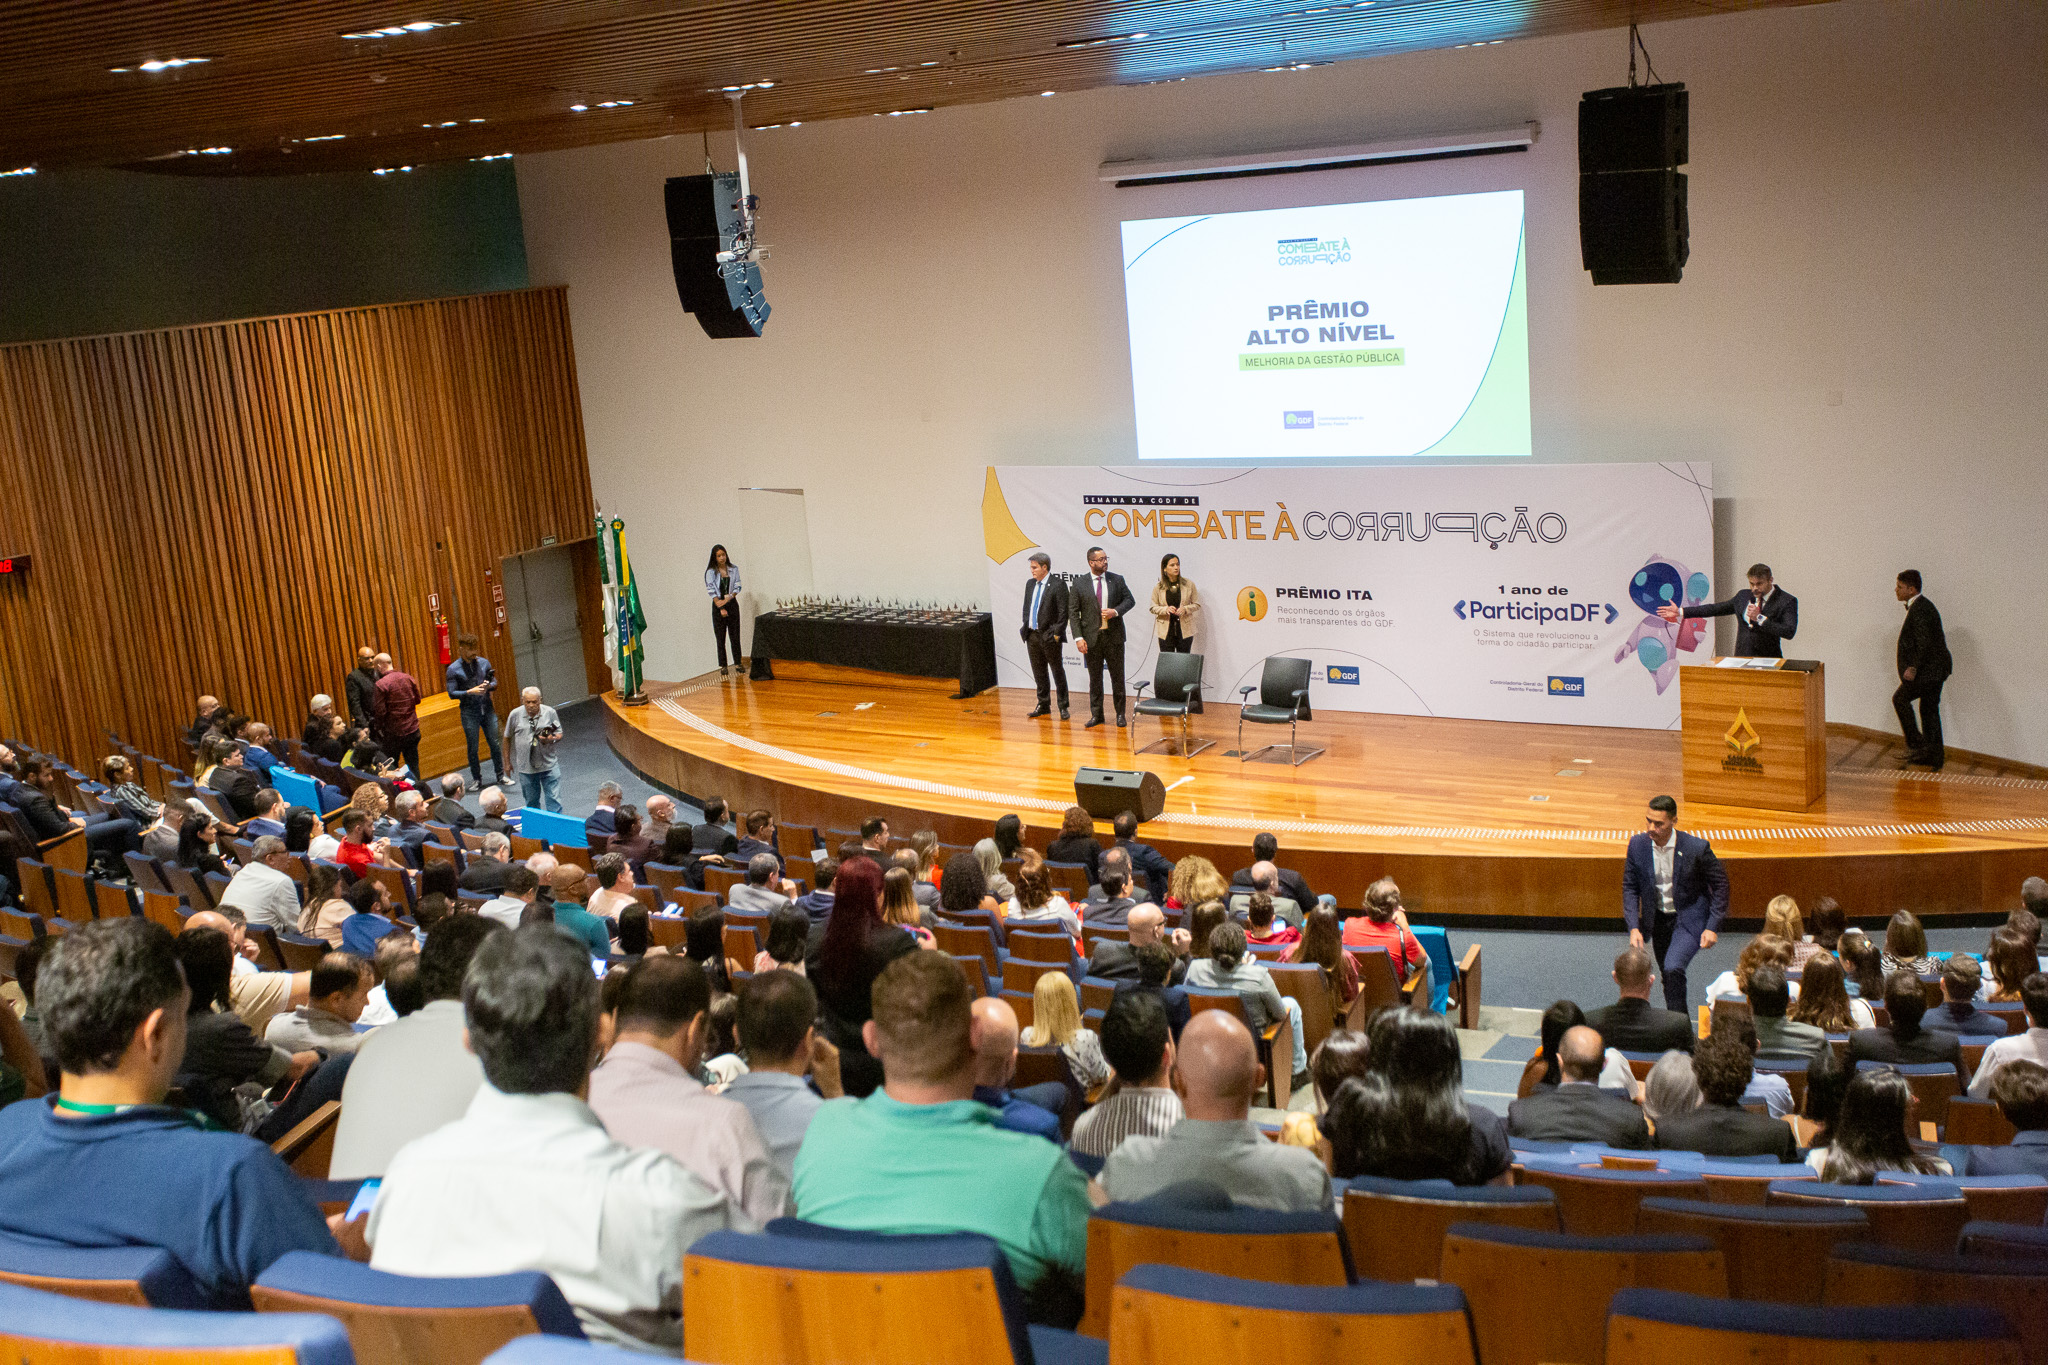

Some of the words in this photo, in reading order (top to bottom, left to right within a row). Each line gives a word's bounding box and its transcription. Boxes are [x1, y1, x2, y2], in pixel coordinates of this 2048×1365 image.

[1268, 300, 1369, 321] PRÊMIO
[1247, 328, 1310, 346] ALTO
[1319, 322, 1395, 342] NÍVEL
[1245, 357, 1294, 367] MELHORIA
[1298, 356, 1311, 365] DA
[1313, 353, 1353, 364] GESTÃO
[1356, 352, 1400, 363] PÚBLICA
[1297, 417, 1312, 425] GDF
[1084, 496, 1126, 504] SEMANA
[1150, 497, 1178, 505] CGDF
[1084, 508, 1267, 541] COMBATE
[1273, 502, 1300, 541] À
[1276, 585, 1341, 600] PRÊMIO
[1346, 590, 1373, 601] ITA
[1498, 585, 1505, 594] 1
[1511, 587, 1542, 595] ano
[1547, 585, 1569, 596] de
[1277, 606, 1340, 616] Reconhecendo
[1355, 608, 1386, 619] órgãos
[1470, 600, 1600, 626] ParticipaDF
[1299, 617, 1358, 627] transparentes
[1360, 619, 1372, 627] do
[1374, 619, 1396, 628] GDF.
[1473, 629, 1480, 637] O
[1482, 629, 1516, 638] Sistema
[1518, 631, 1534, 641] que
[1536, 630, 1591, 640] revolucionou
[1477, 638, 1501, 646] forma
[1503, 638, 1514, 647] do
[1516, 638, 1550, 648] cidadão
[1552, 641, 1596, 650] participar.
[1341, 672, 1358, 680] GDF
[1564, 683, 1582, 692] GDF
